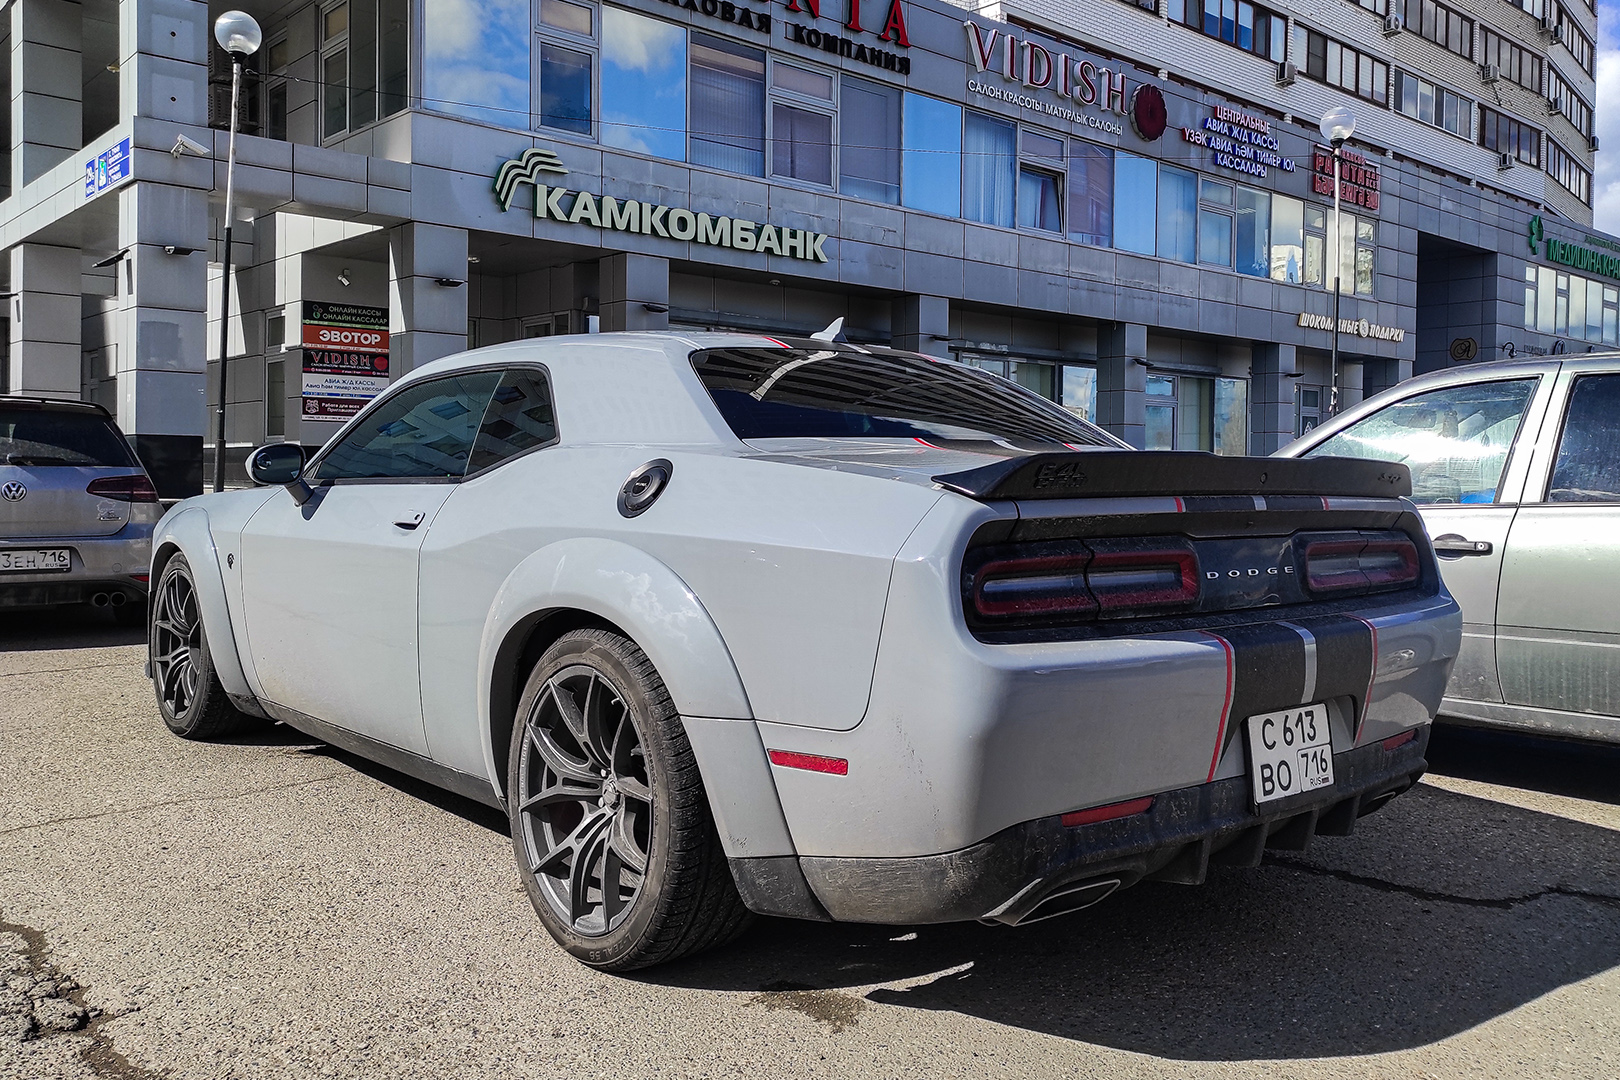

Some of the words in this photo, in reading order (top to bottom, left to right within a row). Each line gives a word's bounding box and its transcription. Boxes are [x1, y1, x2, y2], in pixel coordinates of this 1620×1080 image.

[795, 23, 911, 75] КОМПАНИЯ
[964, 20, 1128, 116] VIDISH
[968, 79, 1003, 99] САЛОН
[1003, 90, 1043, 112] КРАСОТЫ
[1045, 104, 1089, 126] МАТУРЛЫК
[1089, 116, 1123, 136] САЛОНЫ
[1215, 105, 1271, 134] ЦЕНТРАЛЬНЫЕ
[1205, 117, 1229, 136] АВИА
[1231, 125, 1249, 144] Ж/Д
[1250, 131, 1280, 151] КАССЫ
[1210, 136, 1233, 154] АВИА
[1256, 150, 1281, 167] ТИМЕР
[1283, 158, 1297, 172] ЮЛ
[1216, 152, 1268, 178] КАССАЛАРЫ
[1315, 152, 1365, 185] РАОТА
[535, 183, 829, 263] КАМКОМБАНК
[1547, 238, 1602, 274] МЕДИЦИНА
[322, 313, 352, 321] ОНЛАЙН
[352, 316, 388, 324] КАССАЛАР
[328, 305, 357, 314] ОНЛАЙН
[319, 329, 381, 345] ЭВОТОР
[1300, 312, 1359, 335] ШОКОЛНЫЕ
[1369, 324, 1405, 342] ПОДАРКИ
[311, 351, 370, 366] VIDISH
[40, 551, 67, 563] 716
[1206, 565, 1294, 579] DODGE
[1283, 710, 1317, 747] 613
[1300, 749, 1328, 778] 716
[1310, 777, 1322, 787] RUS
